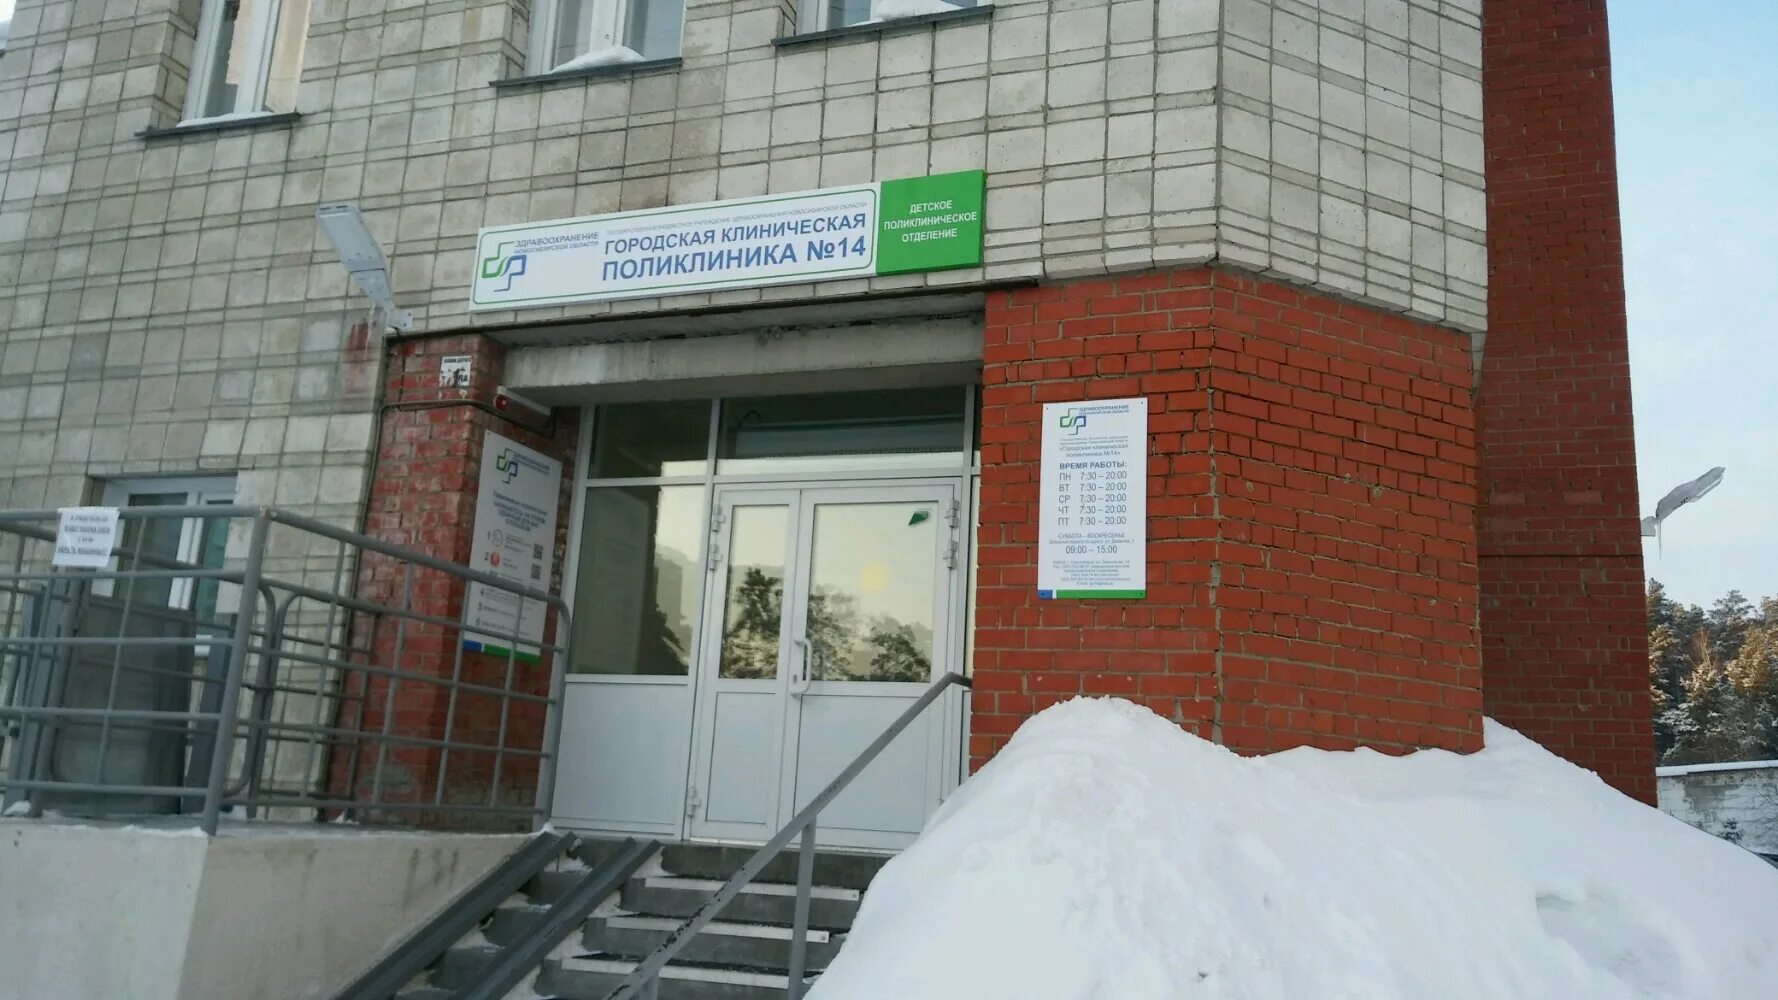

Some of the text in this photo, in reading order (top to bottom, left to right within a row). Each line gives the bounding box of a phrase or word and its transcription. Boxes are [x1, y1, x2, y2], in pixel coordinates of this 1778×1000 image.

[840, 202, 867, 210] ОБЛАСТИ
[909, 200, 952, 214] ДЕТСКОЕ
[884, 212, 977, 230] ПОЛИКЛИНИЧЕСКОЕ
[605, 213, 866, 255] ГОРОДСКАЯ КЛИНИЧЕСКАЯ
[901, 228, 958, 243] ОТДЕЛЕНИЕ
[515, 232, 599, 247] ЗДРАВООХРАНЕНИЕ
[569, 241, 599, 249] ОБЛАСТИ
[602, 236, 866, 281] ПОЛИКЛИНИКА №14
[1059, 472, 1071, 481] ПН
[1106, 471, 1127, 479] 20:00
[1059, 484, 1070, 492] ВТ
[1105, 482, 1127, 491] 20:00
[1058, 495, 1070, 503] СР
[1105, 493, 1127, 502] 20:00
[1058, 506, 1069, 514] ЧТ
[1105, 505, 1127, 513] 20:00
[1058, 517, 1069, 525] ПТ
[1104, 516, 1126, 525] 20:00
[1065, 545, 1087, 554] 09:00
[1096, 545, 1118, 553] 15:00
